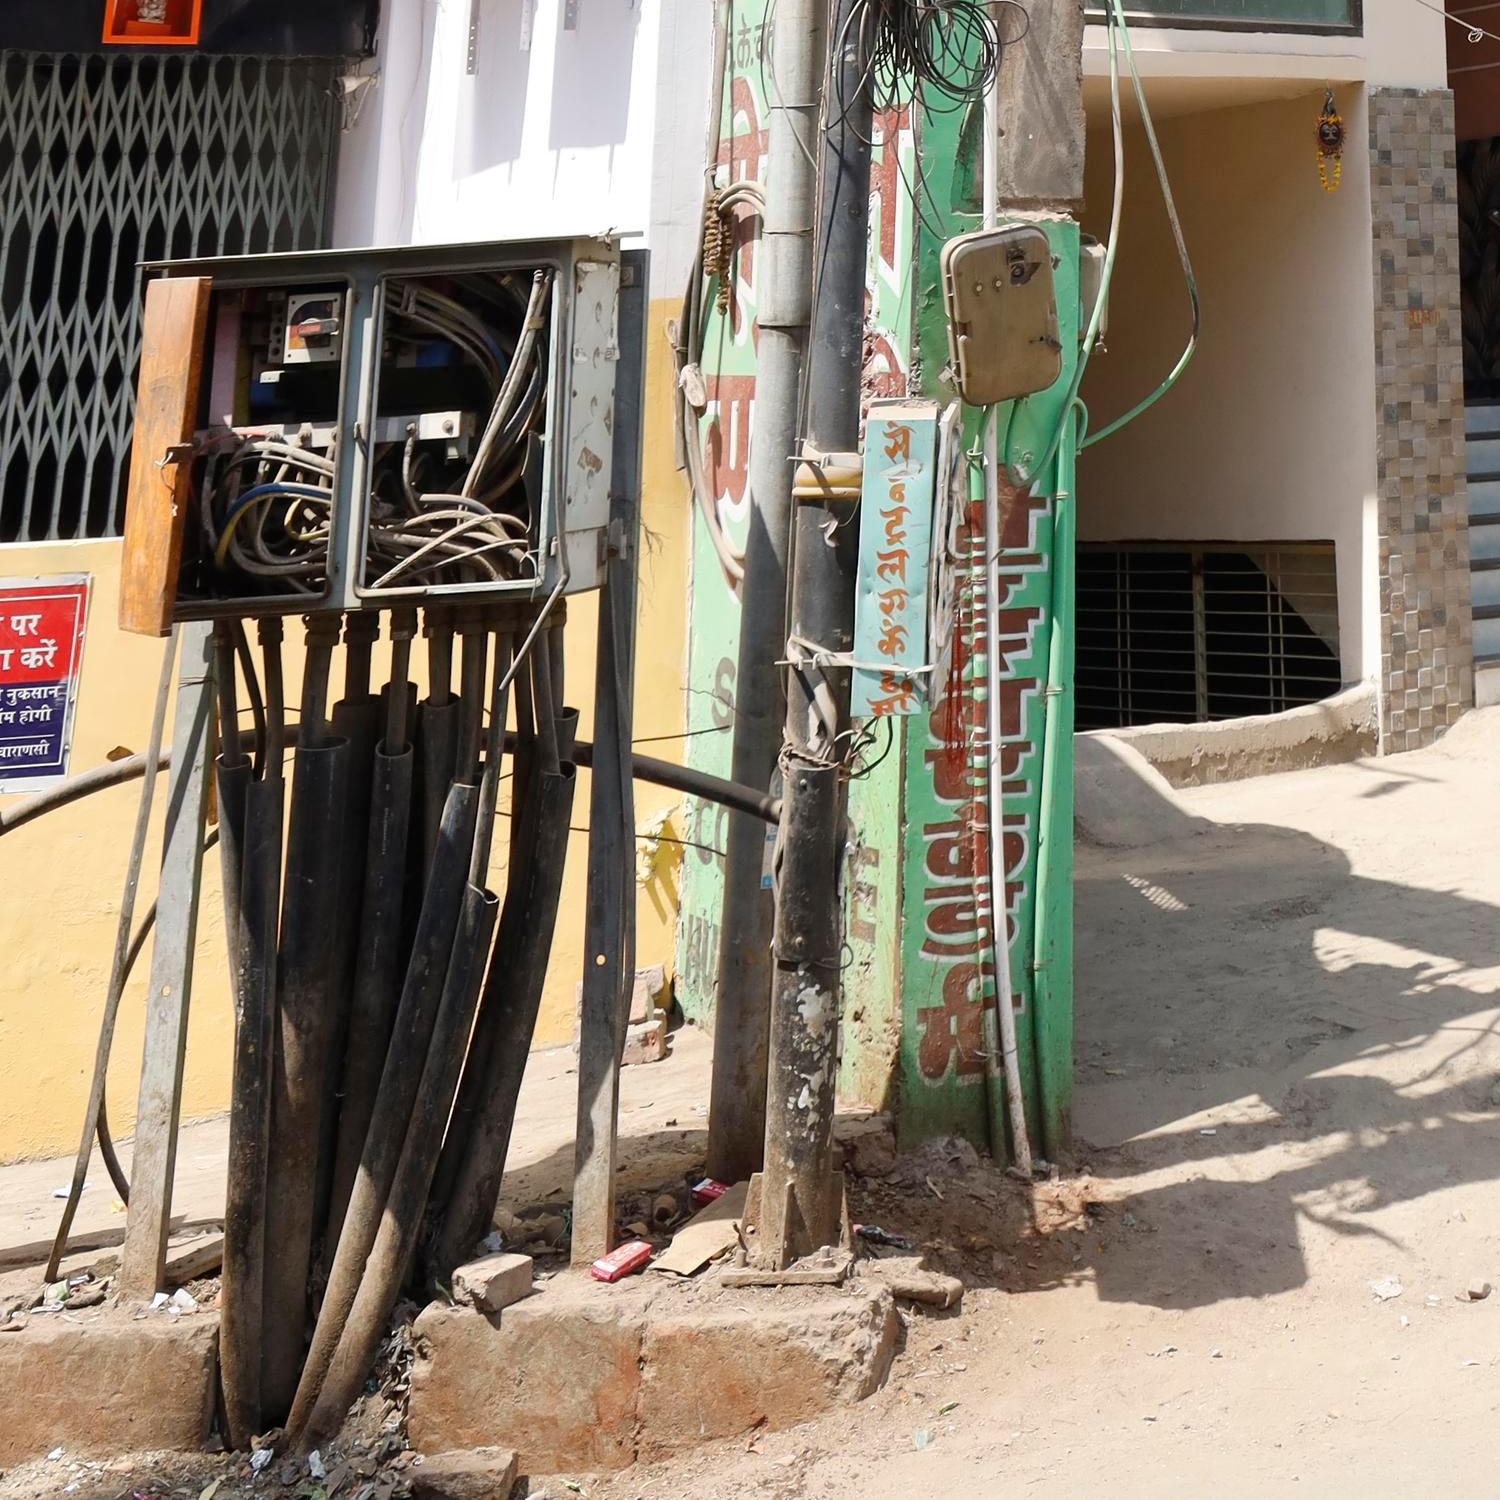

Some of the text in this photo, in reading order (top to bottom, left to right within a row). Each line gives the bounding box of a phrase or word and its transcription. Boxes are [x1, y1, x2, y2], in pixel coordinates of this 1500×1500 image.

[10, 613, 43, 637] पर
[20, 638, 59, 669] करें
[6, 685, 61, 706] नुकसान
[19, 703, 53, 726] होगी
